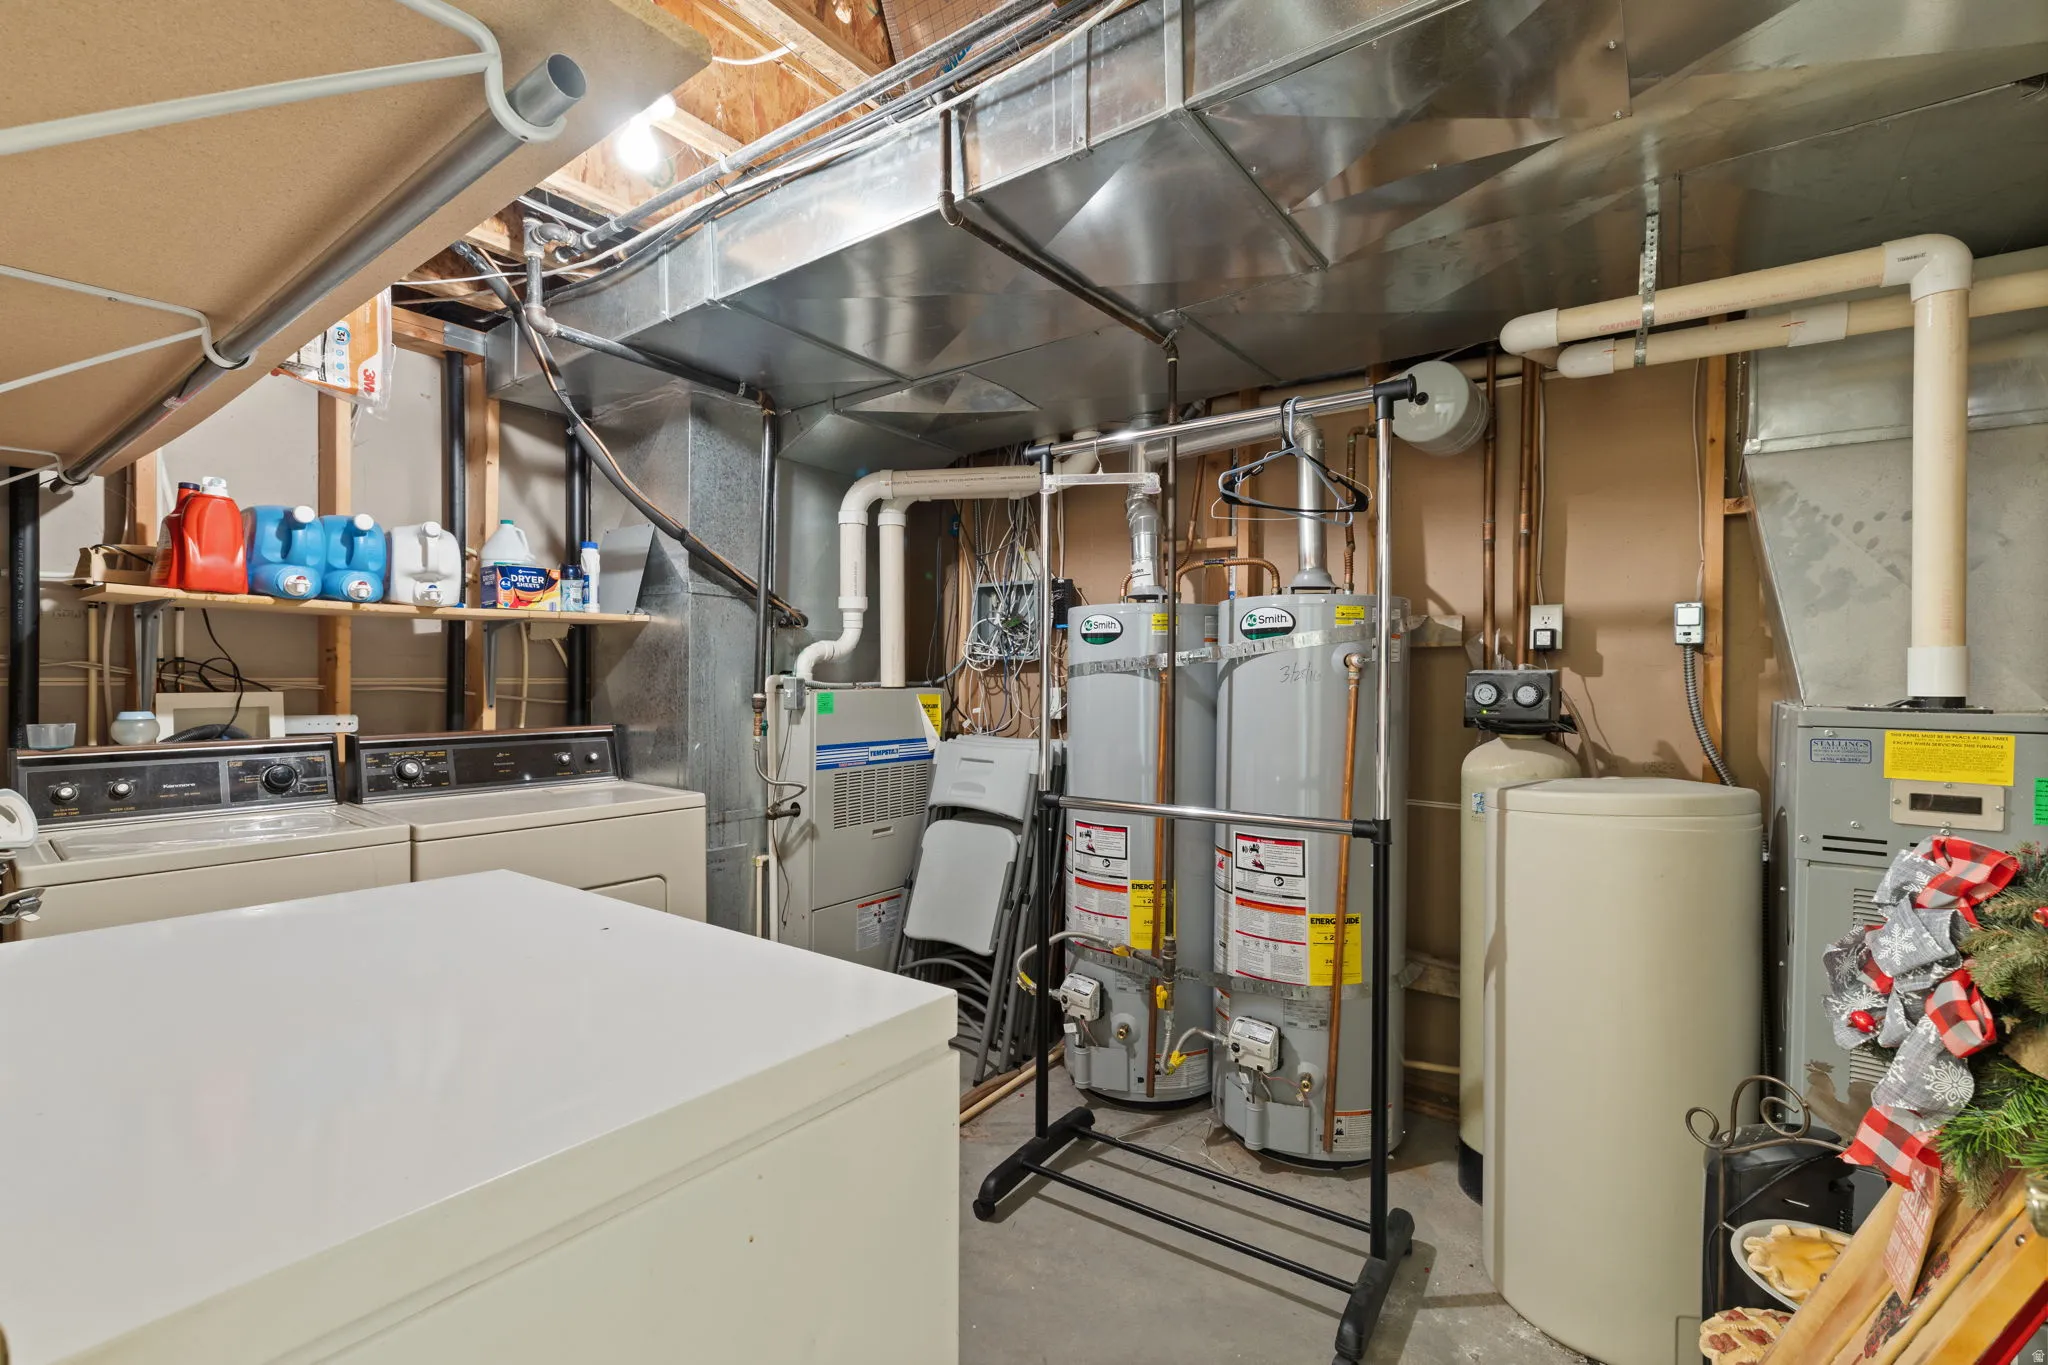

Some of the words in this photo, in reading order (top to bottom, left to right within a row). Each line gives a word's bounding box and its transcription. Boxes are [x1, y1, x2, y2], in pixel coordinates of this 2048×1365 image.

[363, 368, 376, 393] 3M
[511, 574, 545, 584] DRYER
[1258, 613, 1287, 624] Smith
[1093, 621, 1116, 629] Smith
